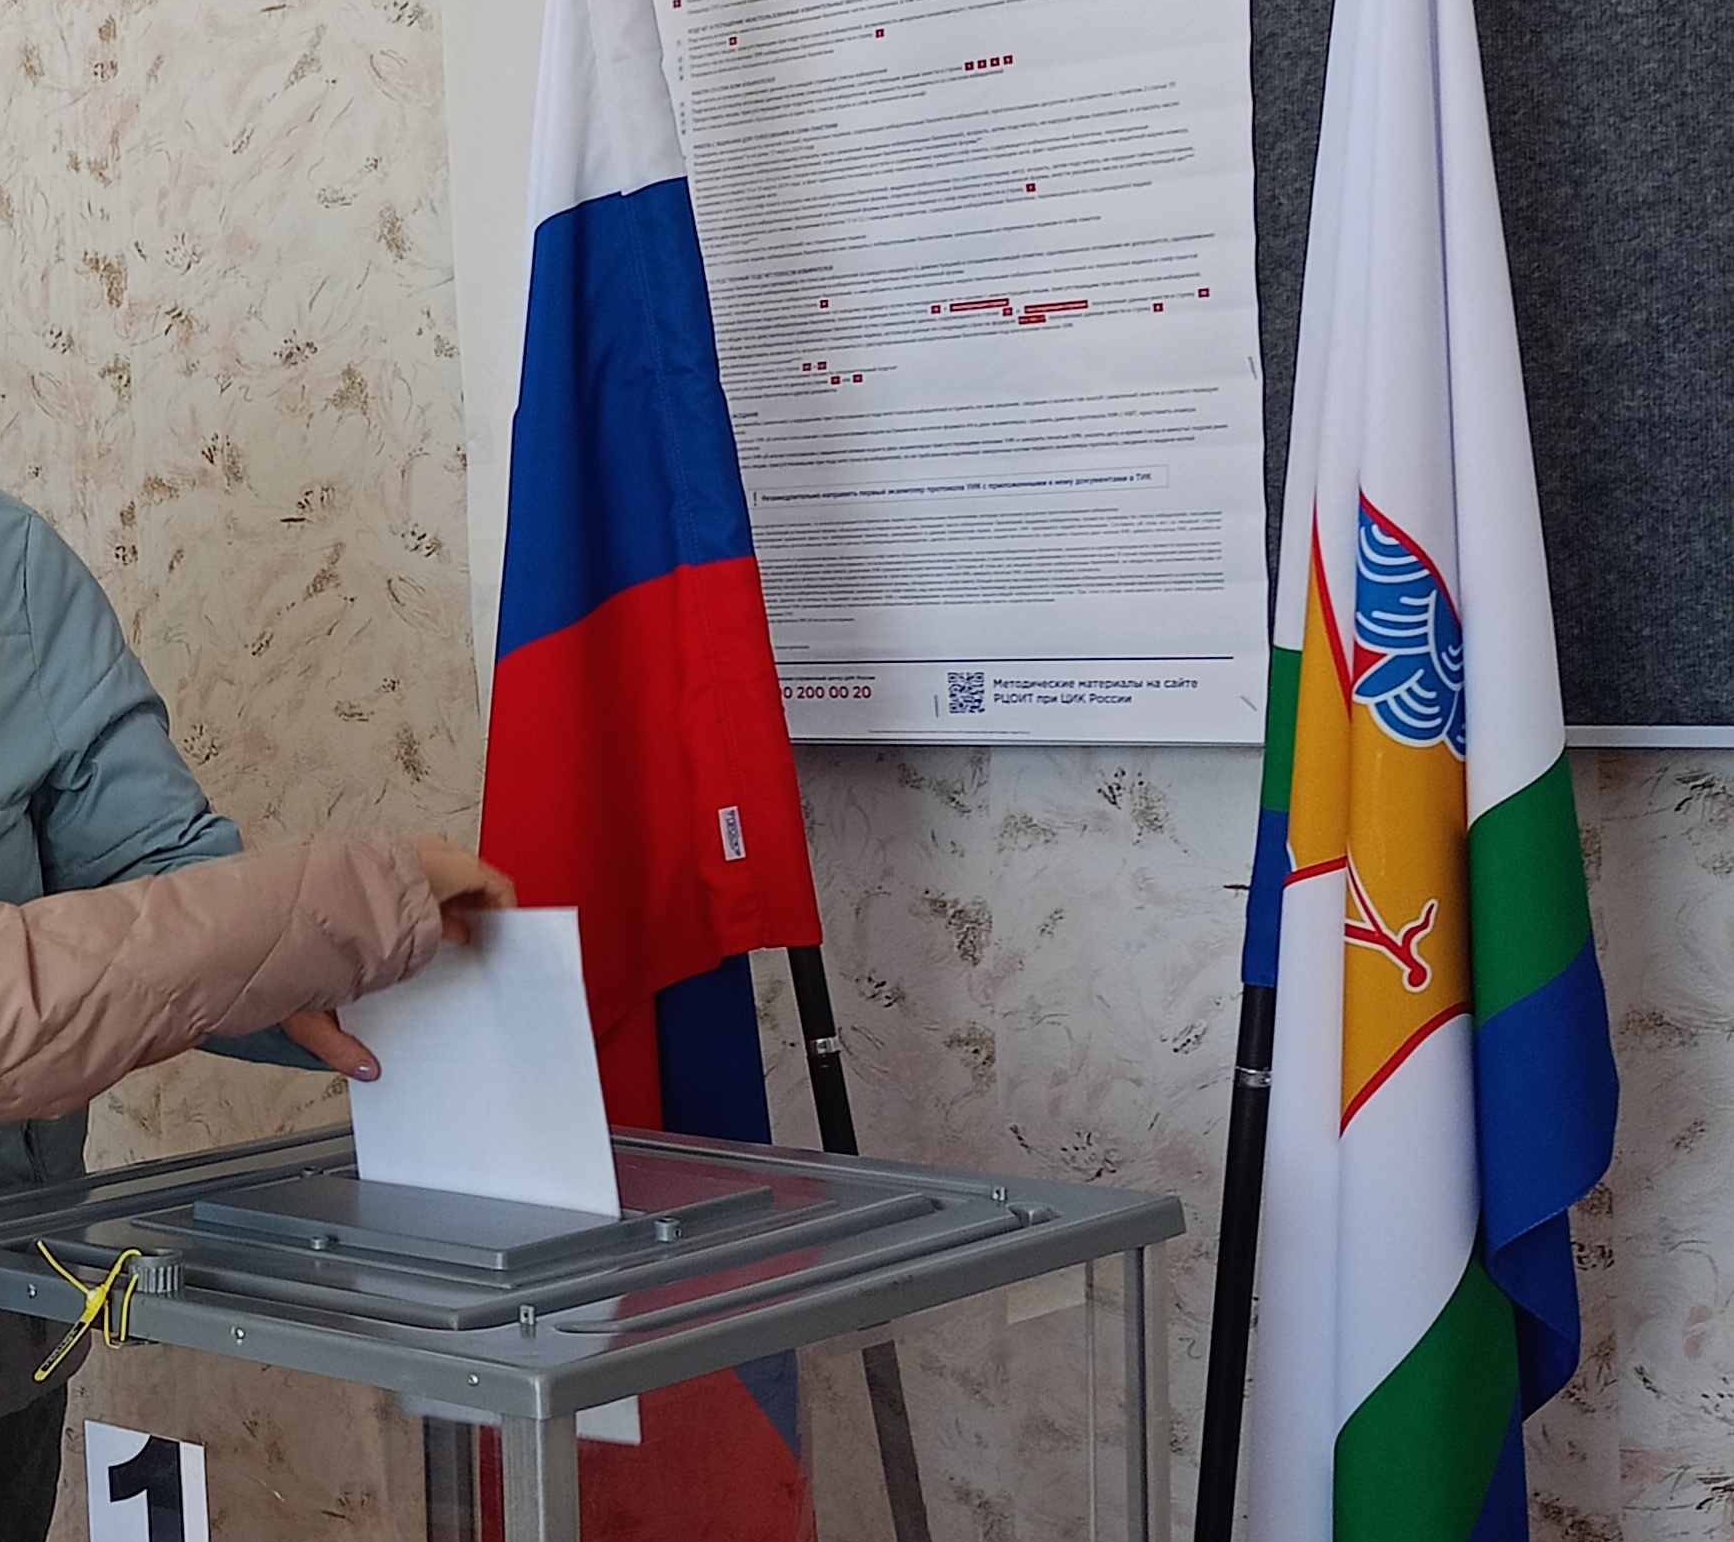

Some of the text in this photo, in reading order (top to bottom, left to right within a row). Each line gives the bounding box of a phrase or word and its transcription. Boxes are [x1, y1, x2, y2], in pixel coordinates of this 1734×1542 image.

[993, 677, 1198, 691] Методические материалы на сайте
[797, 686, 825, 699] 200
[829, 686, 849, 699] 00
[853, 686, 871, 698] 20
[993, 693, 1132, 705] РЦОИТ при ЦИК России
